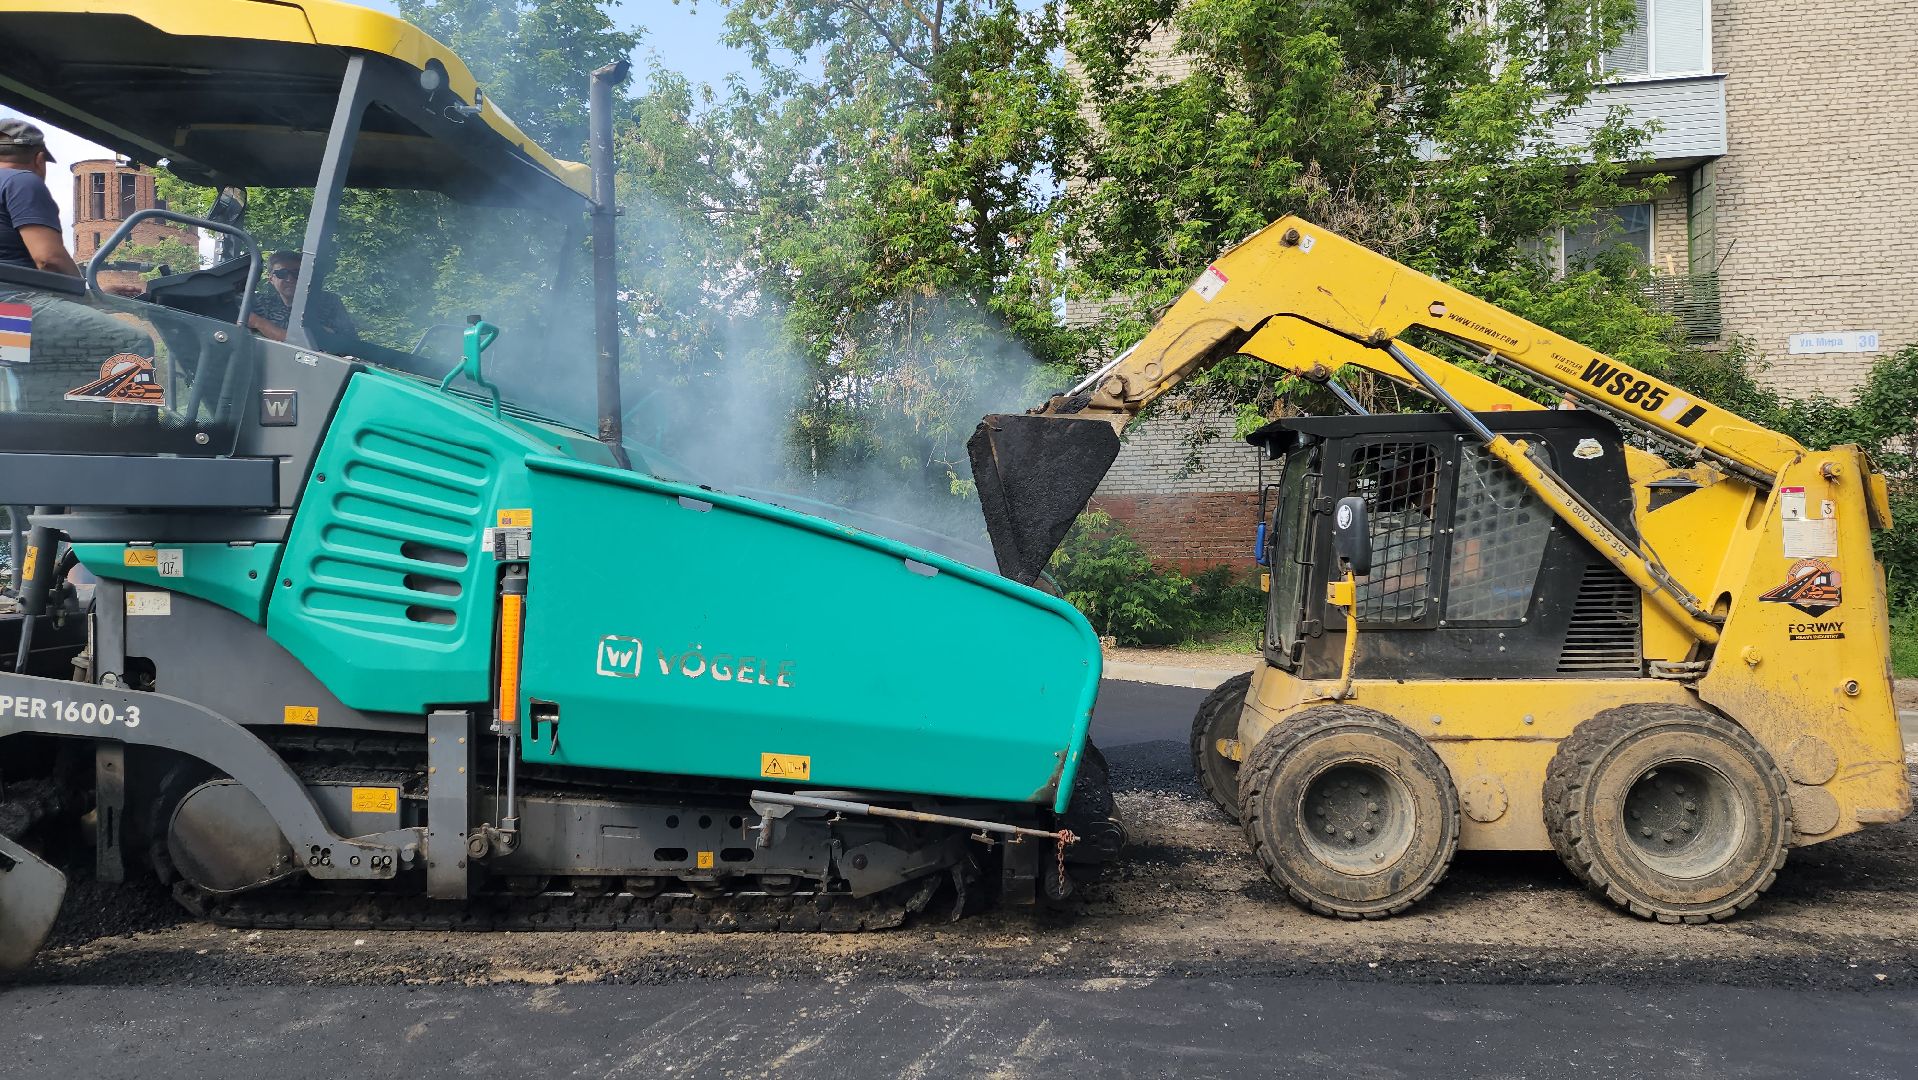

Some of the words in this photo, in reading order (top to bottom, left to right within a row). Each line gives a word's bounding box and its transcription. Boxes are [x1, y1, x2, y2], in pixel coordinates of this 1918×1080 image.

[1816, 337, 1844, 347] Мира
[1858, 335, 1875, 348] 30
[1580, 359, 1670, 412] WS85
[1823, 503, 1832, 515] 3
[1565, 499, 1574, 507] 8
[1572, 507, 1590, 522] 800
[1611, 541, 1629, 557] 393
[1788, 622, 1845, 633] FORWAY
[656, 643, 796, 688] VÖGELE
[51, 700, 141, 728] 1600-3
